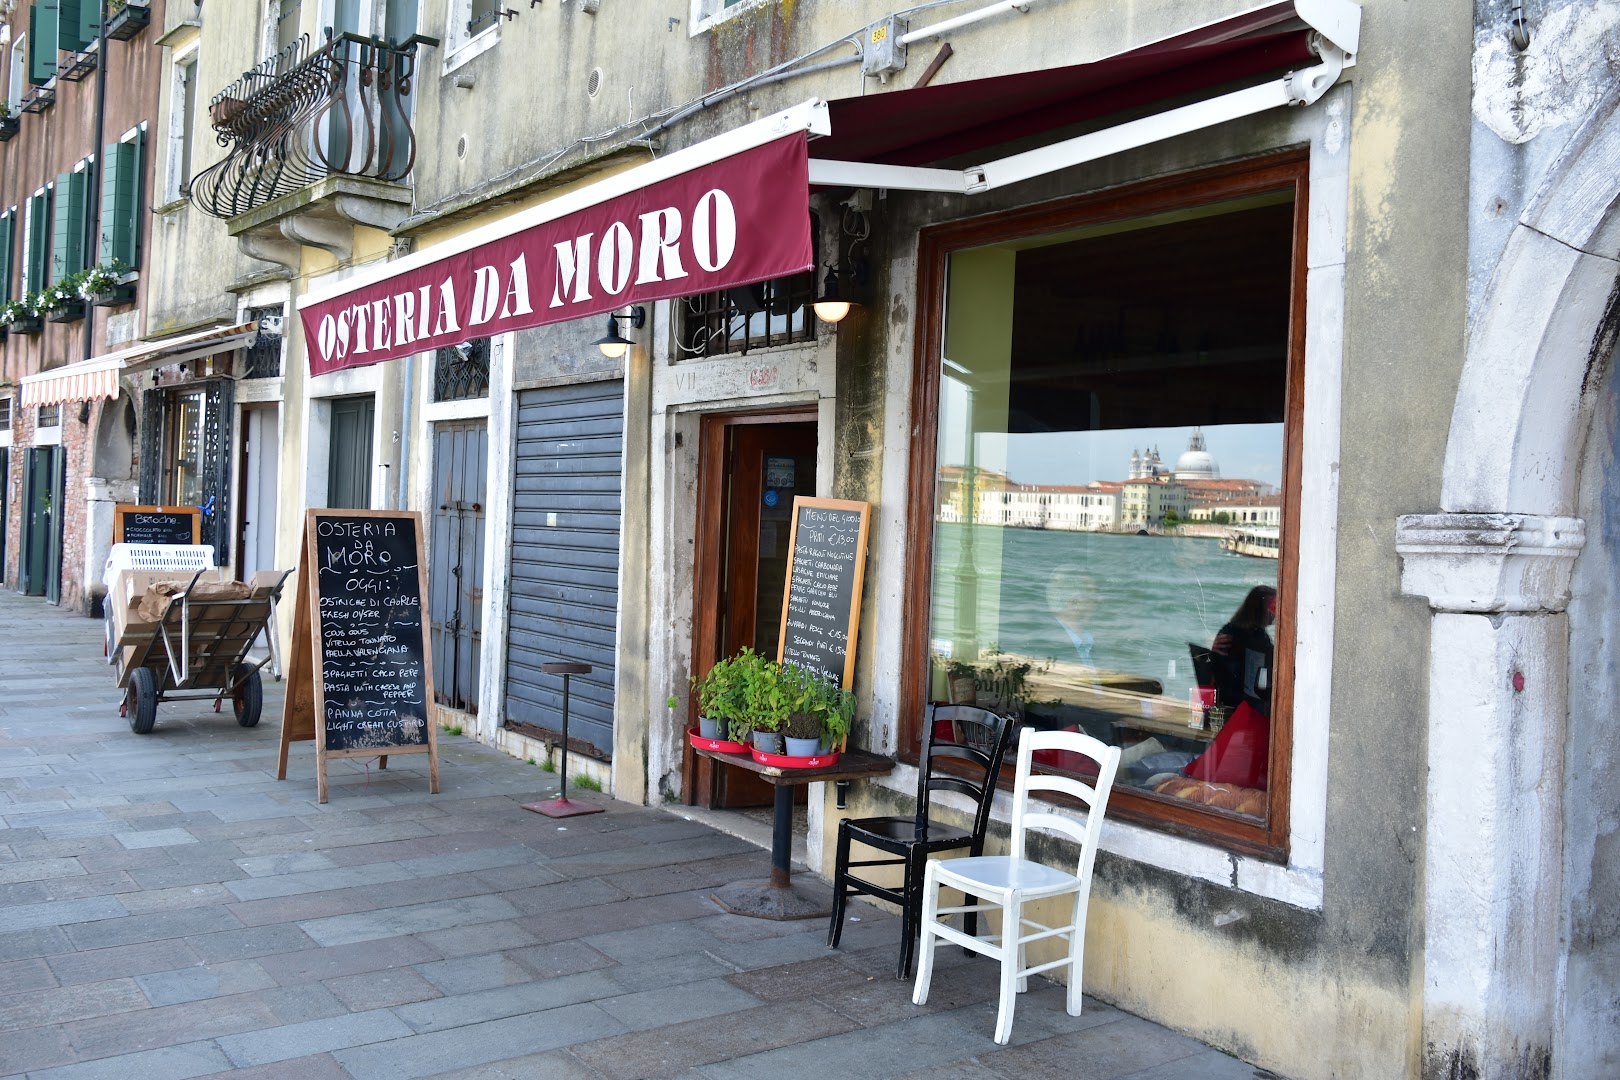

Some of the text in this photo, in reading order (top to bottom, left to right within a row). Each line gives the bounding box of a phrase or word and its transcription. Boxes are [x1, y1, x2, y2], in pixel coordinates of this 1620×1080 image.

[873, 28, 885, 42] 380
[317, 189, 737, 361] OSTERIA DA MORO
[829, 512, 840, 522] DEL
[318, 521, 396, 537] OSTERIA
[354, 540, 373, 550] DA
[327, 546, 391, 568] MORO
[320, 595, 418, 606] OSTRICHE DI CAORLE
[321, 610, 349, 619] FRESH
[326, 635, 396, 648] VITELLO TONNATO
[326, 644, 408, 658] PAELLA VALENCIANA
[323, 670, 368, 679] SPAGHETTI
[399, 668, 418, 678] PEPE
[324, 682, 350, 692] PASTA
[354, 683, 373, 692] WITH
[402, 682, 416, 690] AND
[383, 689, 415, 698] PEPPER
[327, 708, 397, 719] PANNA COTTA
[326, 718, 424, 730] LIGHT CREAM CUSTARD
